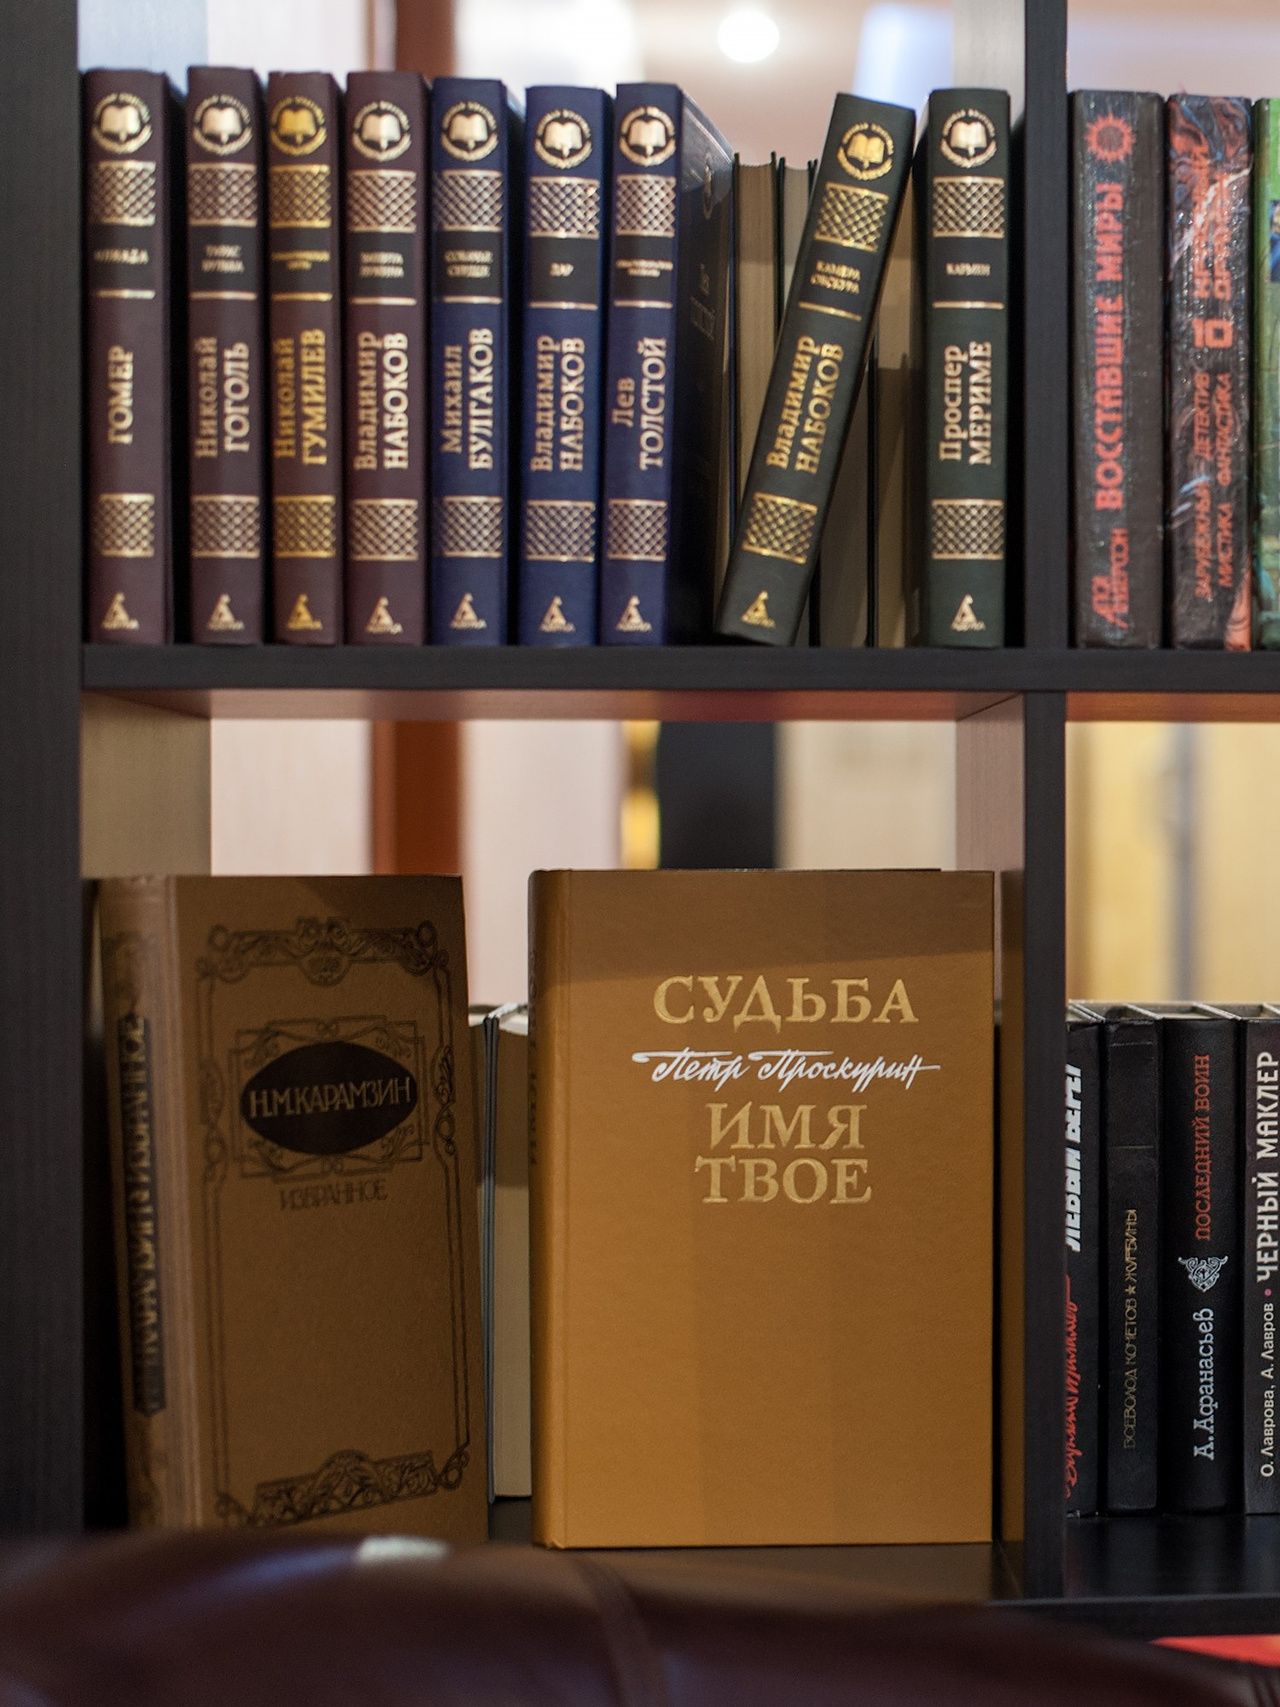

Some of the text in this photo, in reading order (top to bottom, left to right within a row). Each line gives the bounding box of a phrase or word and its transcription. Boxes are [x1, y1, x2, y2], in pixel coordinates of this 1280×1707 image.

[110, 346, 134, 445] ГОМЕР
[196, 336, 218, 458] Николай
[223, 342, 250, 452] ГОГОЛЬ
[275, 337, 296, 458] Николай
[301, 328, 328, 466] ГУМИЛЕВ
[354, 331, 382, 471] Владимир
[383, 332, 409, 471] НАБОКОВ
[441, 344, 462, 453] Михаил
[469, 327, 494, 471] БУЛГАКОВ
[531, 335, 560, 473] Владимир
[560, 337, 585, 473] НАБОКОВ
[612, 377, 636, 428] Лев
[637, 337, 667, 471] ТОЛСТОЙ
[765, 336, 822, 470] Владимир
[794, 343, 844, 475] НАБОКОВ
[939, 345, 968, 462] Проспер
[968, 341, 993, 465] МЕРИМЕ
[1095, 182, 1123, 510] ВОССТАВШИЕ МИРЫ
[1194, 372, 1212, 461] ДЕТЕКТИВ
[1216, 373, 1233, 587] МИСТИКА ФАНТАСТИКА
[632, 1047, 941, 1092] Петр Проскурин
[653, 974, 919, 1034] СУДЬБА
[695, 1155, 872, 1204] ТВОЕ
[705, 1101, 867, 1150] ИМЯ
[1192, 1054, 1212, 1241] ПОСЛЕДНИЙ ВОИН
[1251, 1052, 1279, 1283] ЧЕРНЫЙ МАКЛЕР
[279, 1179, 388, 1211] ИЗБРАННОЕ
[1124, 1209, 1138, 1449] ВСЕВОЛОД КОЧЕТОВ ЖУРБИНЫ
[1260, 1303, 1276, 1478] О. Лаврова, А. Лавров
